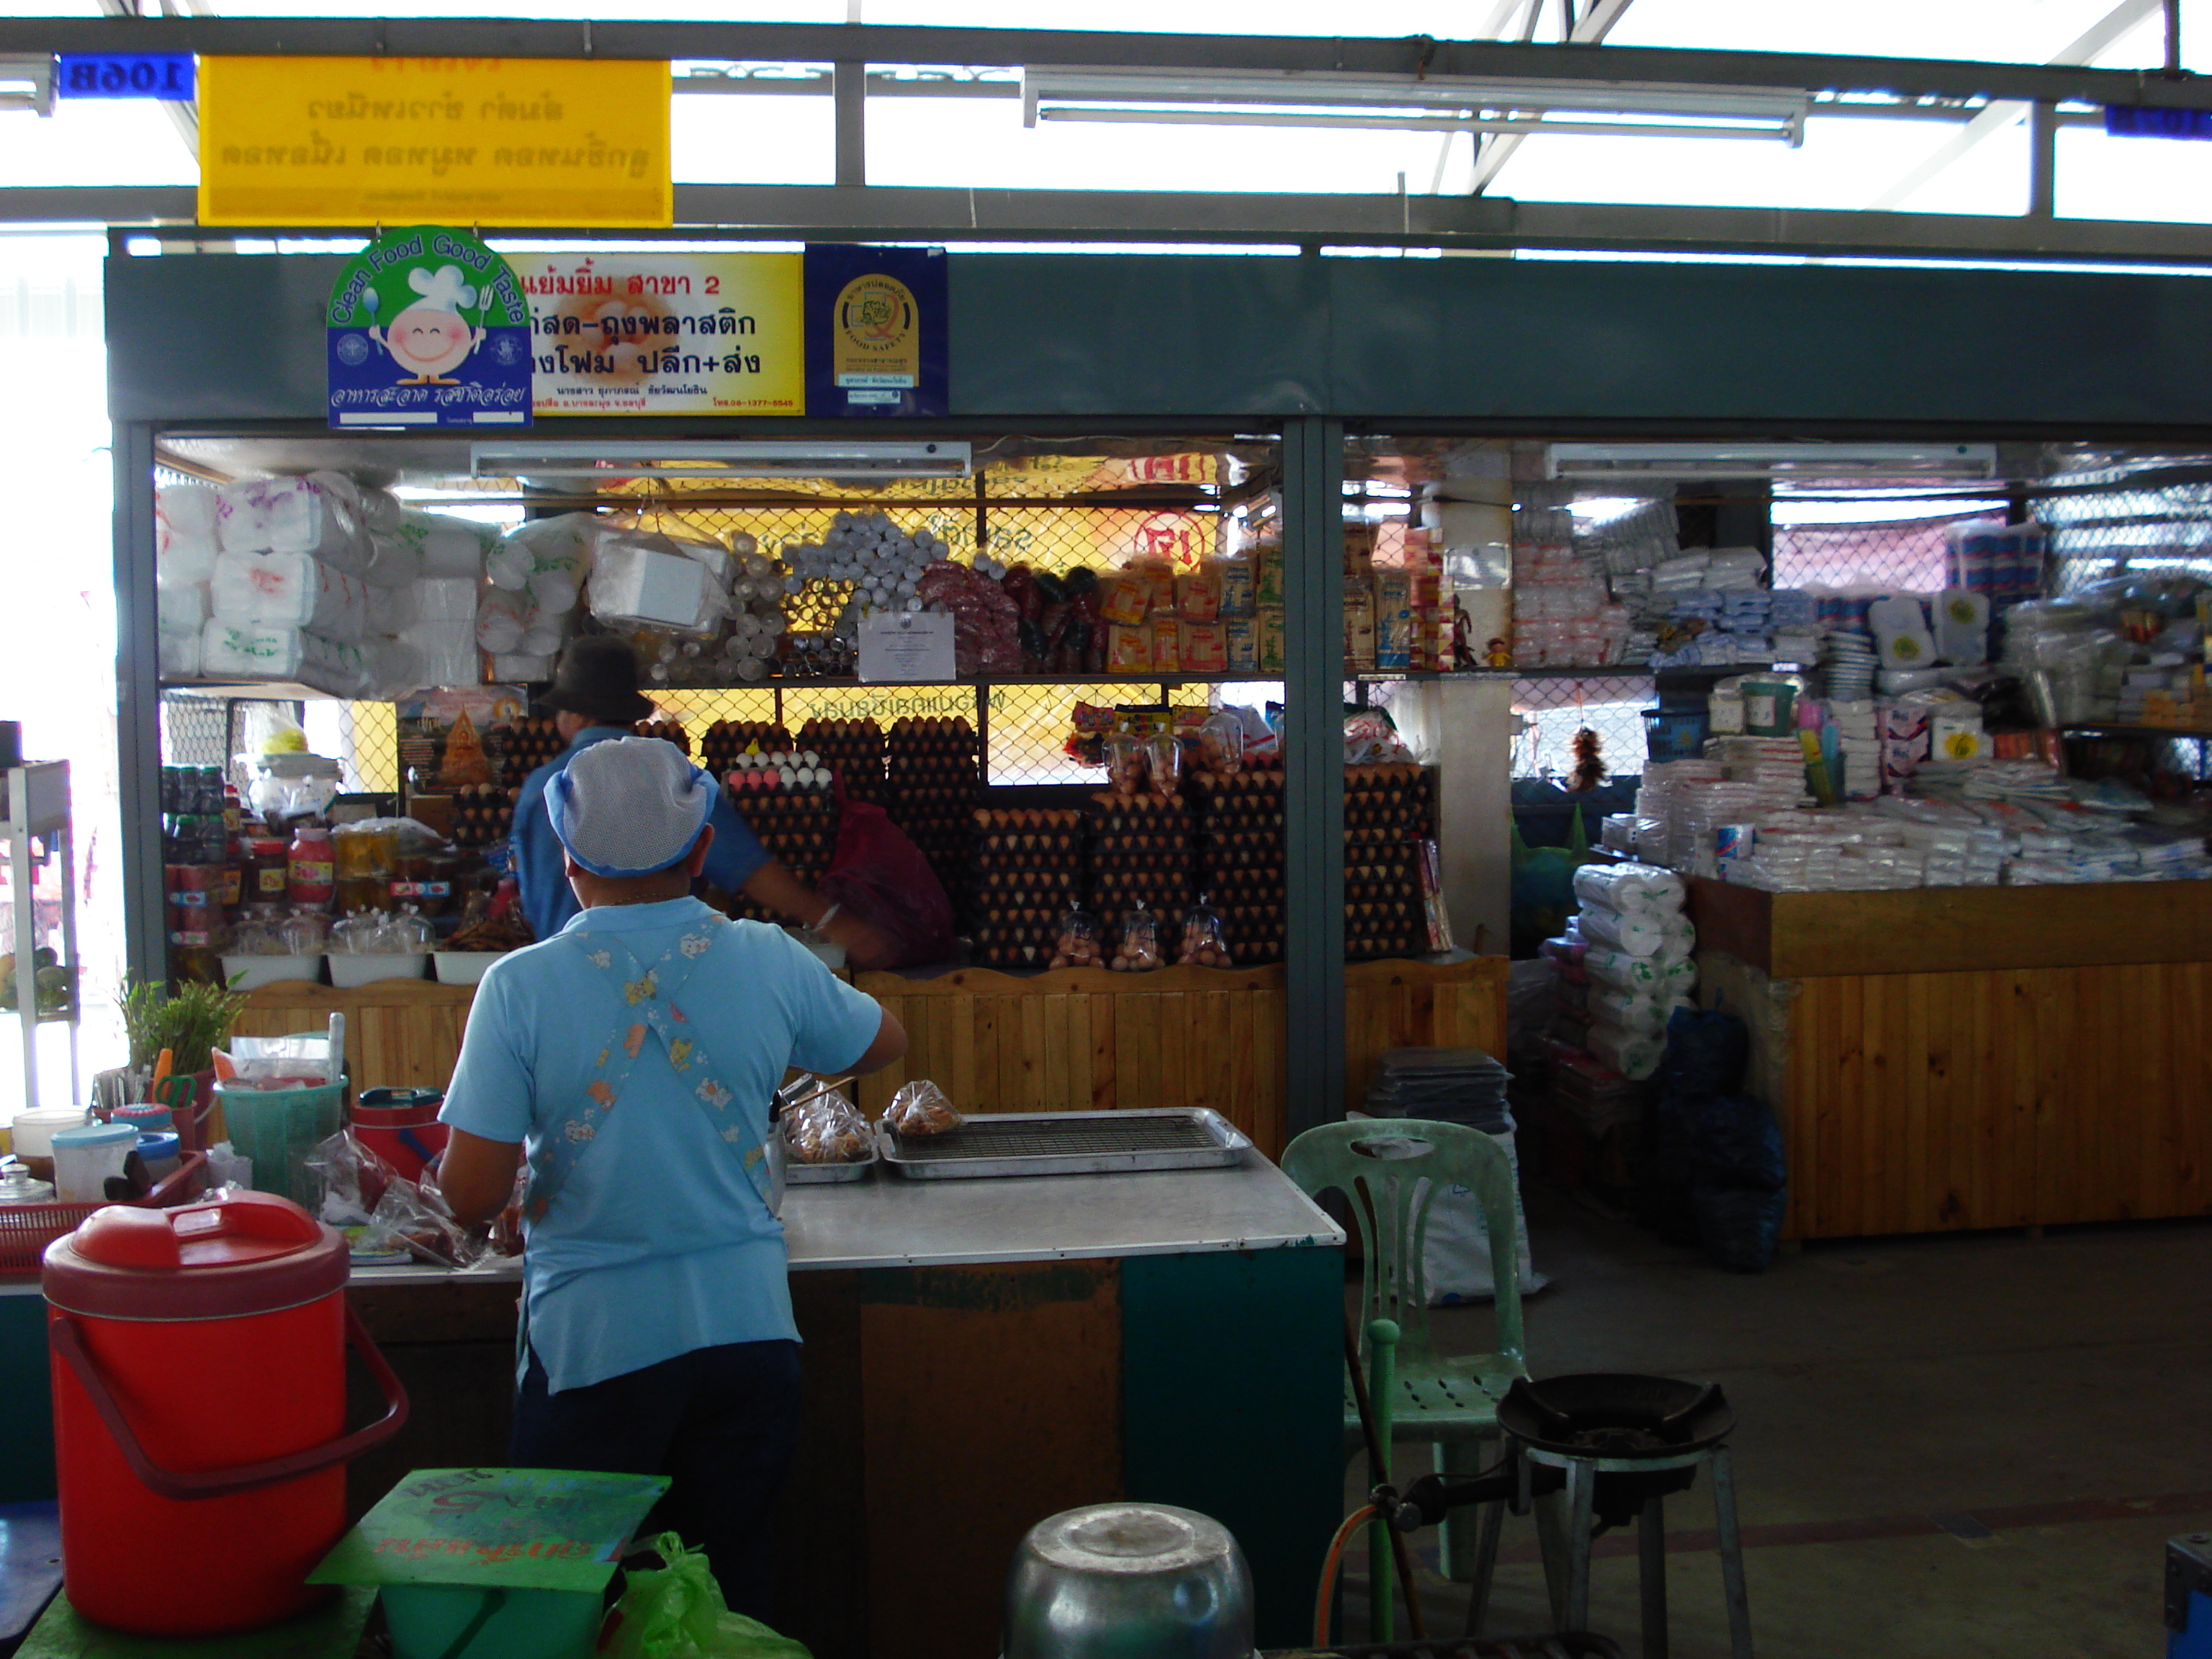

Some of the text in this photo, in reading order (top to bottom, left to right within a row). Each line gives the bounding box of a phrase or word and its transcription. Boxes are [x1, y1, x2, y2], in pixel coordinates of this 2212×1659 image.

[331, 234, 526, 324] Clean Food Good Taste
[627, 274, 691, 295] สาขา
[704, 275, 721, 295] 2
[331, 385, 428, 407] อาหารสะอาด
